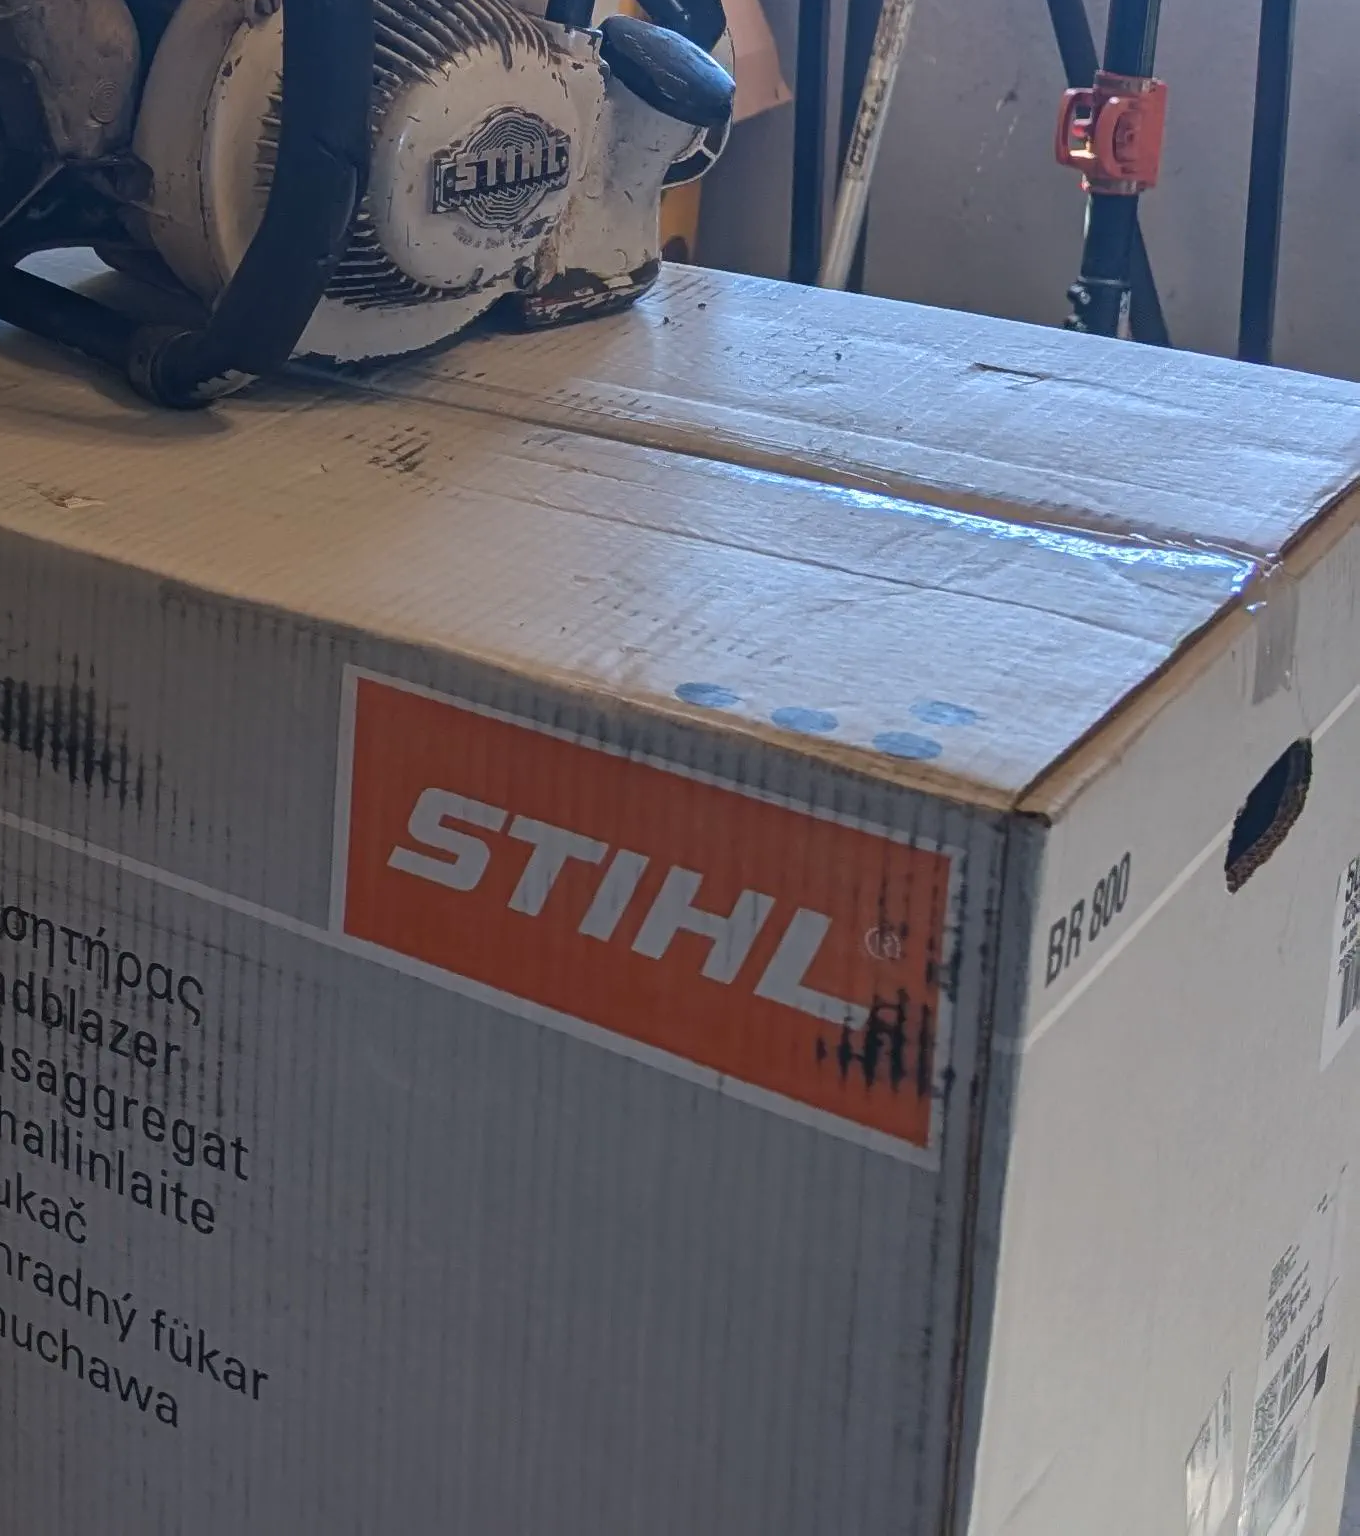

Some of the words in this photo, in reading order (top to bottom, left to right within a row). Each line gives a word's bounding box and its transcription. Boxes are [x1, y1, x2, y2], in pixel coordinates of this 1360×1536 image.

[454, 135, 560, 192] STIHL
[386, 786, 874, 1032] STIHL
[1045, 899, 1086, 988] BR
[1088, 851, 1131, 942] 800
[151, 1310, 270, 1401] fükar
